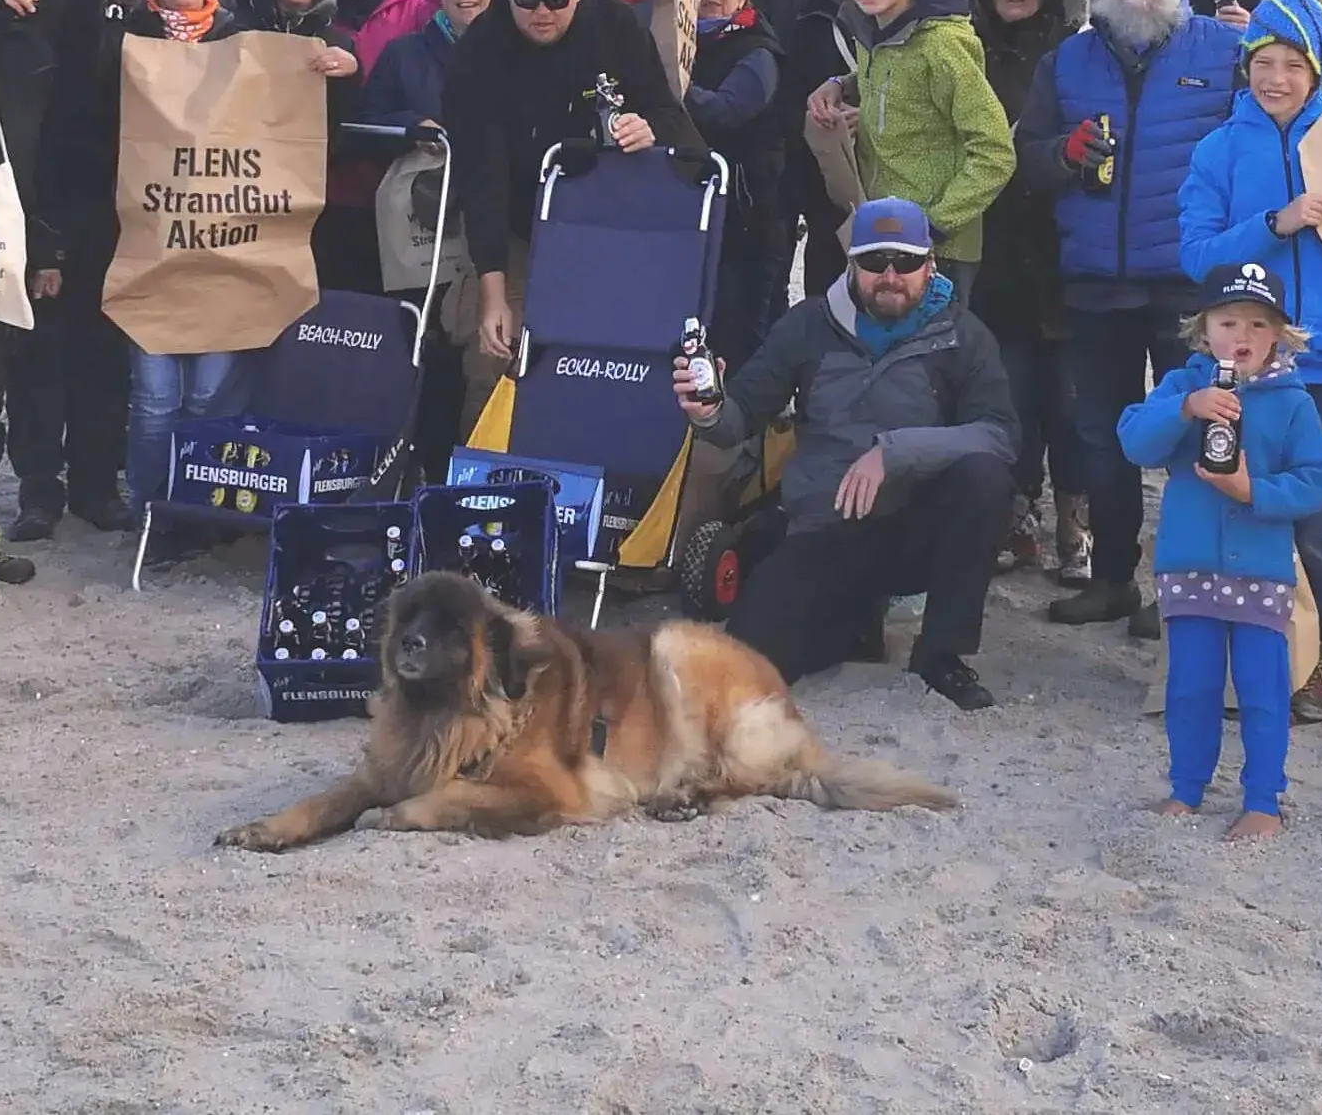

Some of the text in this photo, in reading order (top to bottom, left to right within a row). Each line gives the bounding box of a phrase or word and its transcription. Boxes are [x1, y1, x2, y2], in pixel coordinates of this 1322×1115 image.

[173, 147, 261, 178] FLENS
[142, 183, 292, 214] StrandGut
[166, 219, 259, 249] Aktion
[298, 324, 382, 350] BEACH-ROLLY
[556, 356, 650, 382] ECKLA-ROLLY
[185, 464, 288, 493] FLENSBURGER
[282, 689, 373, 701] FLENSBURG
